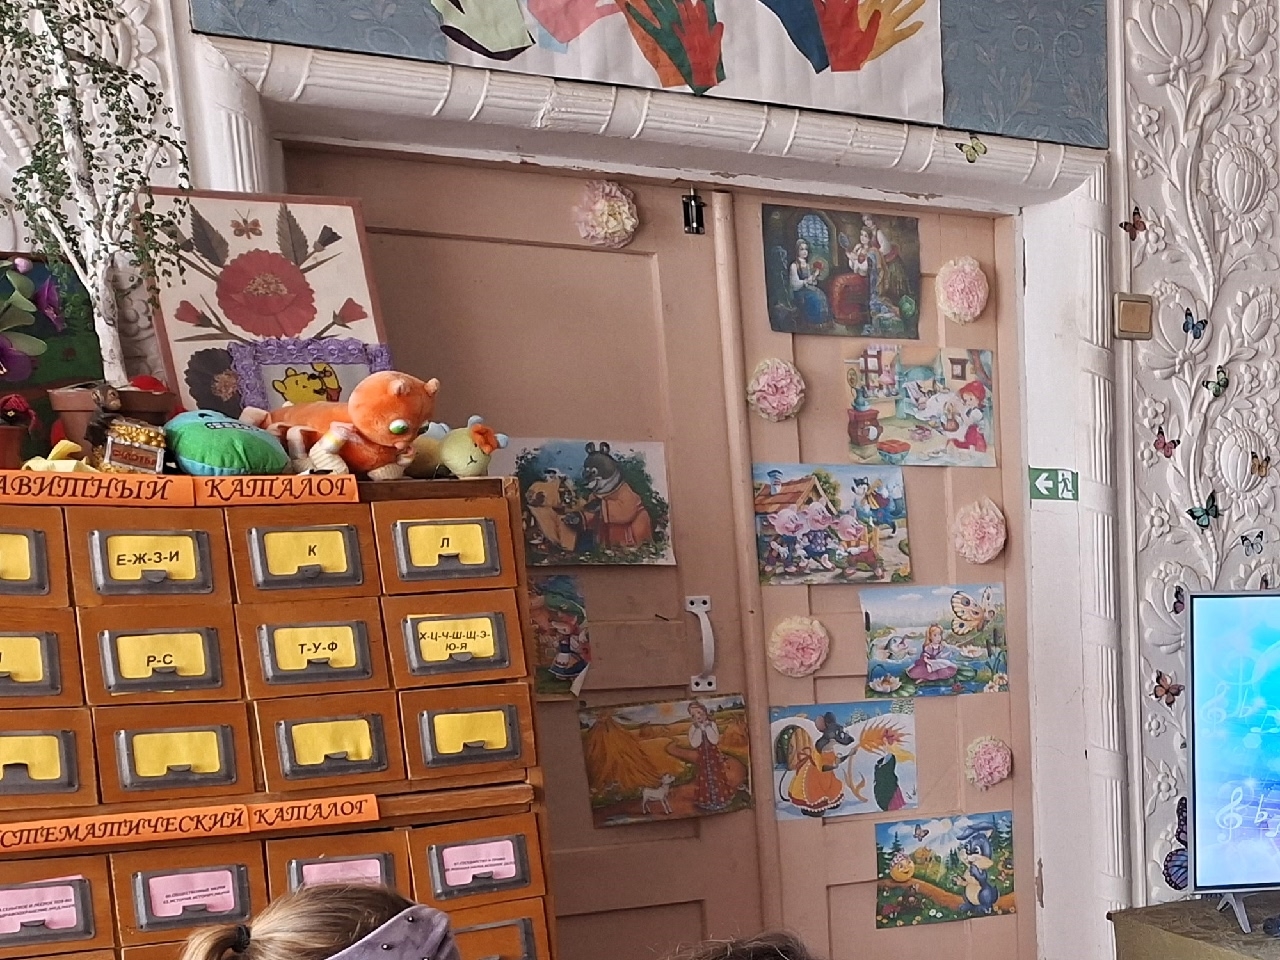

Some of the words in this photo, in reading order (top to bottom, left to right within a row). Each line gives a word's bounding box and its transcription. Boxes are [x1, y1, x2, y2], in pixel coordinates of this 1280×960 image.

[205, 477, 353, 500] КАТАЛОГ
[439, 537, 450, 548] Л
[308, 545, 317, 557] К
[116, 550, 180, 567] Е-Ж-З-И
[298, 641, 339, 655] Т-У-Ф
[445, 641, 468, 652] Ю-Я
[146, 653, 174, 667] Р-С
[0, 807, 244, 848] СТЕМАТИЧЕСКИЙ
[254, 799, 370, 827] КАТАЛОГ
